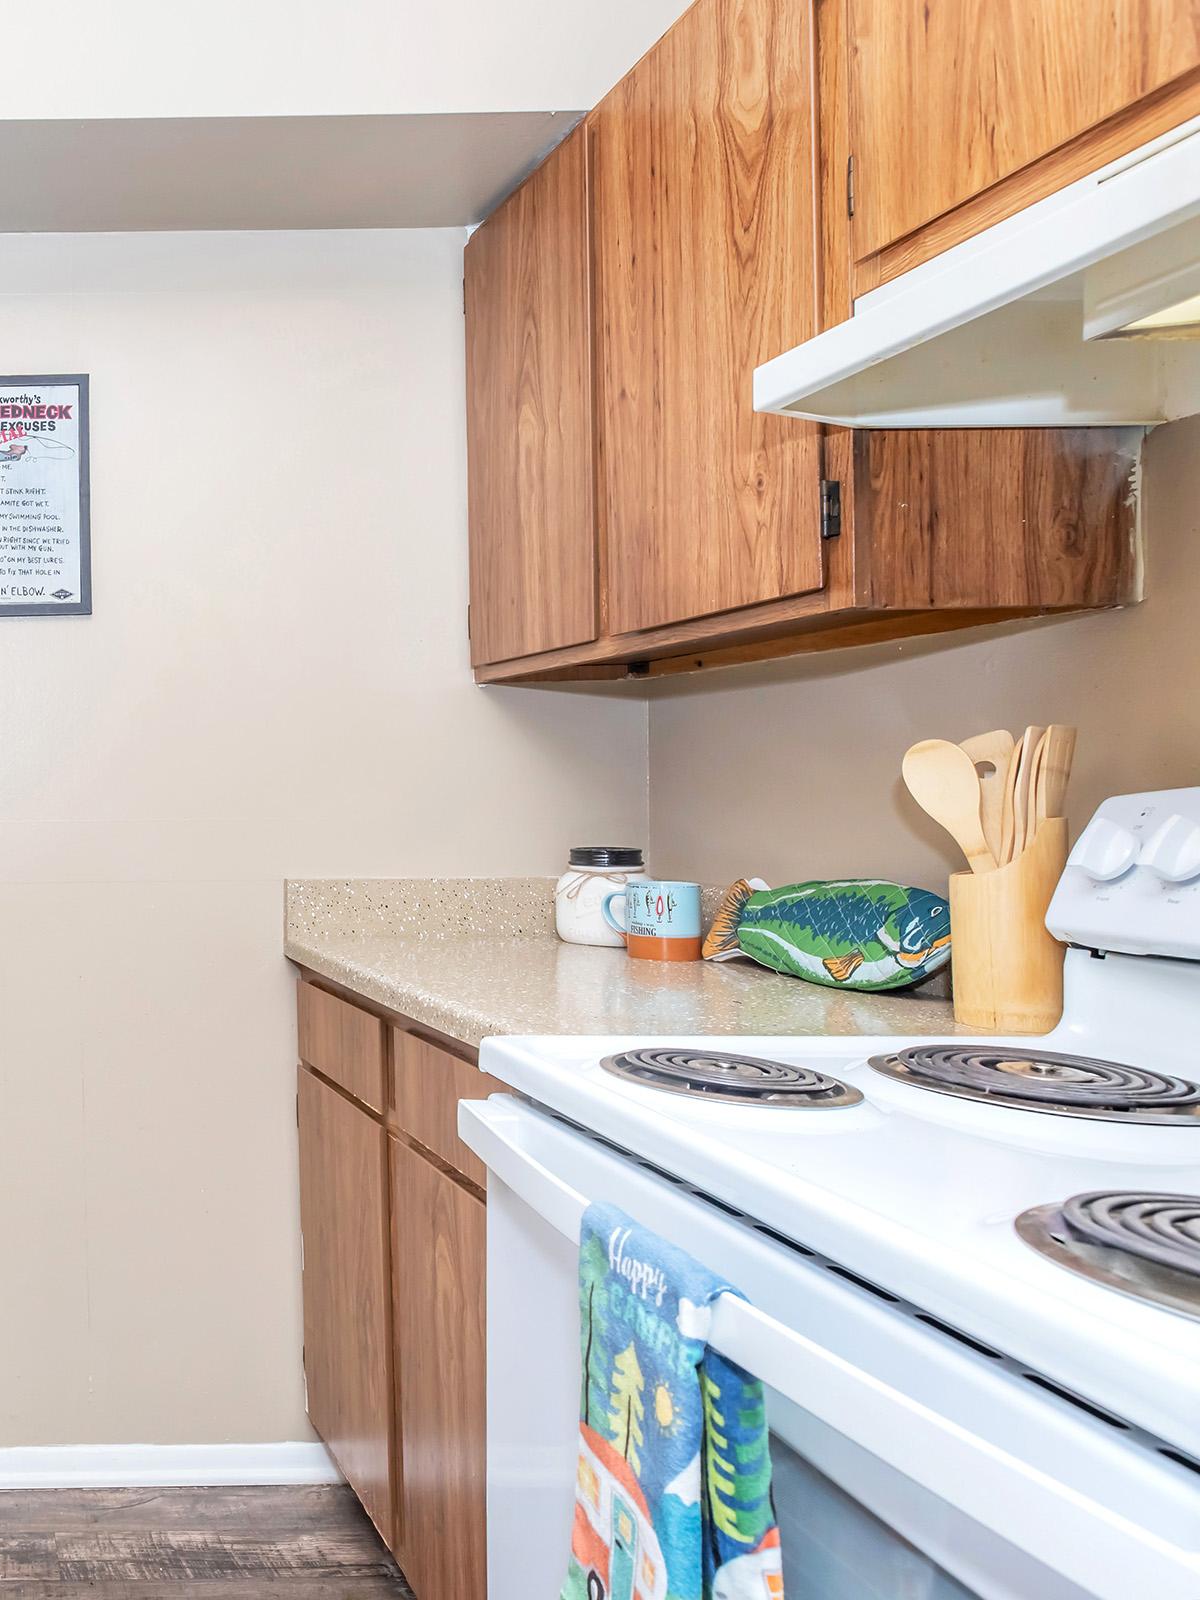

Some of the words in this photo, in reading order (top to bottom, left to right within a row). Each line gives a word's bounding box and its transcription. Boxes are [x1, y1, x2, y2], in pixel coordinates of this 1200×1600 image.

[0, 420, 56, 432] EXCUSES
[5, 487, 24, 495] STINK
[21, 499, 34, 507] GOT
[8, 512, 41, 521] SWIMMING
[3, 536, 22, 544] RIGHT
[22, 537, 41, 545] SINCE
[52, 537, 70, 545] TRIED
[16, 556, 26, 564] MY
[27, 556, 42, 564] BEST
[0, 568, 7, 576] TO
[17, 568, 34, 576] THAT
[35, 568, 53, 576] HOLE
[11, 586, 46, 597] ELBOW.
[630, 924, 657, 937] FISHING
[608, 1225, 668, 1308] Happy
